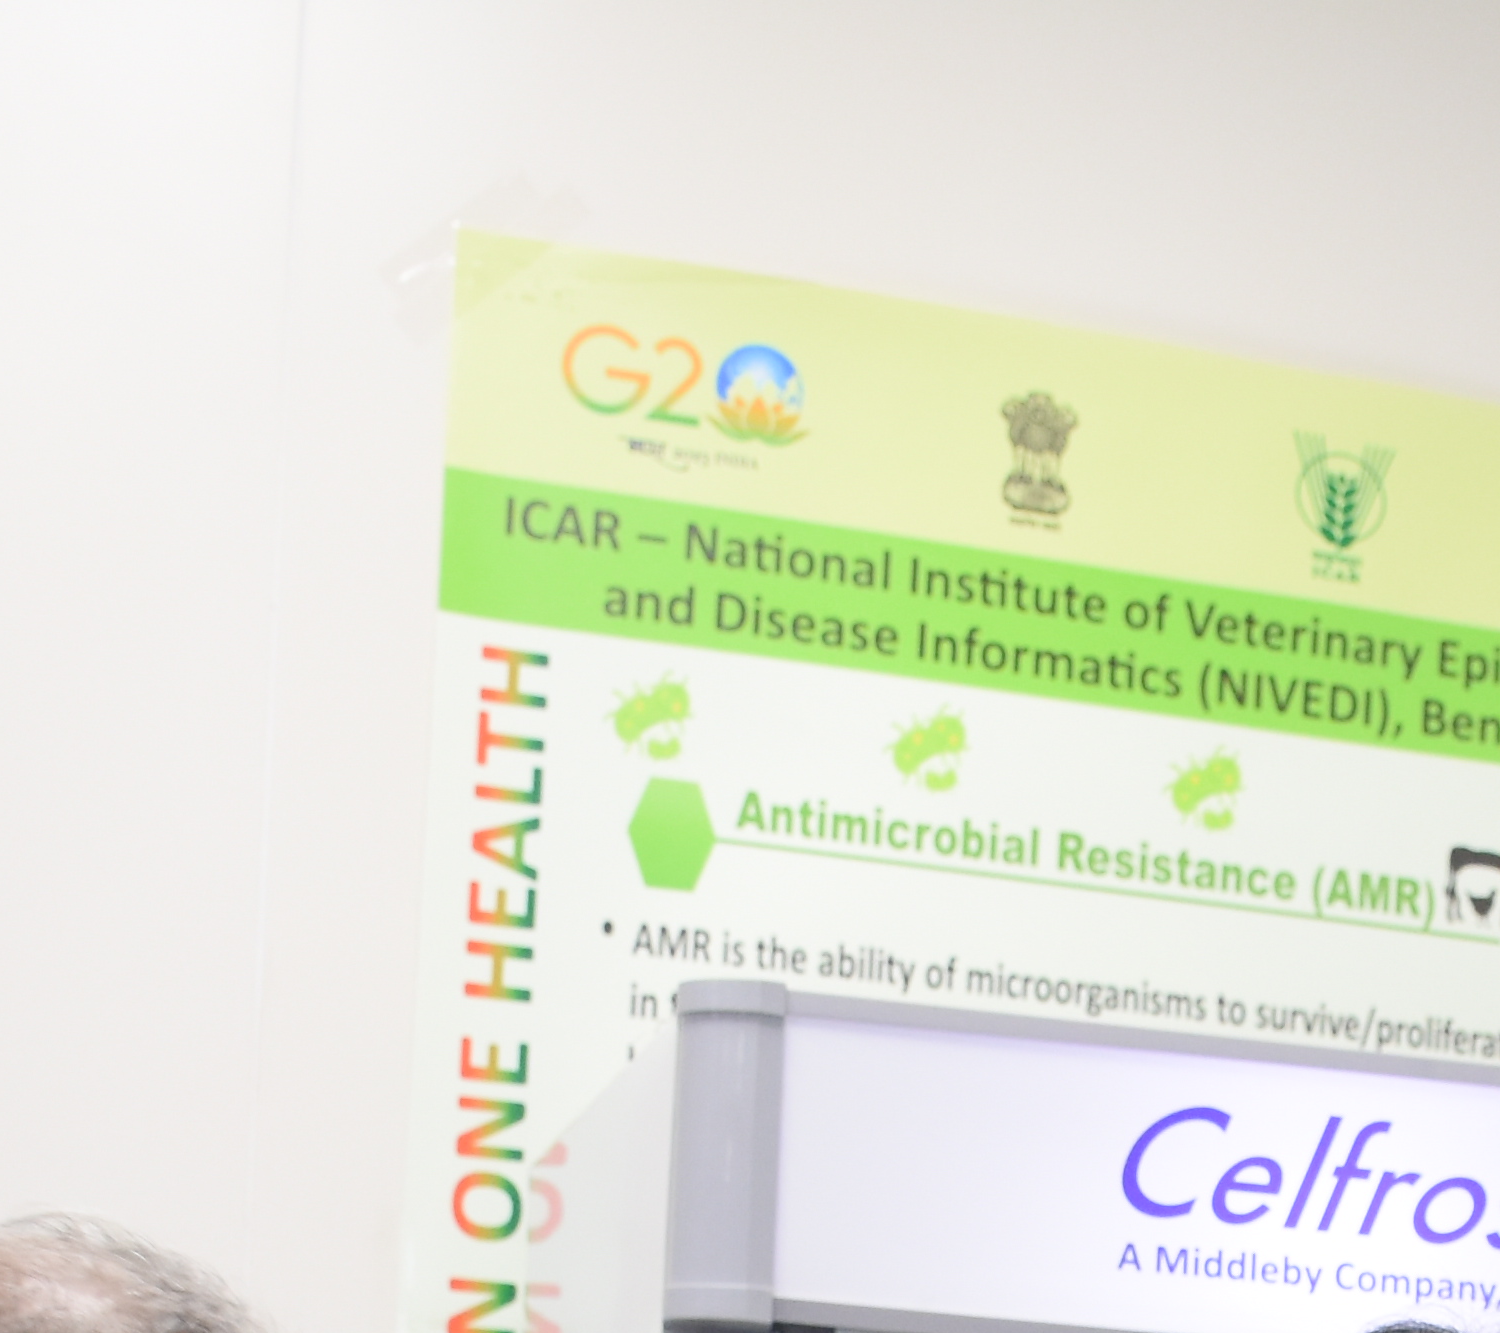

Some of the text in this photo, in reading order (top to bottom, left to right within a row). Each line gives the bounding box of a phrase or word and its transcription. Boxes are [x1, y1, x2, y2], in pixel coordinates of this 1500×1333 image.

[505, 497, 621, 551] ICAR
[686, 523, 891, 590] National
[910, 557, 1106, 624] Institute
[1125, 593, 1170, 630] of
[1186, 600, 1422, 679] Veterinary
[605, 584, 694, 626] and
[716, 593, 898, 656] Disease
[918, 623, 1181, 697] Informatics
[1200, 666, 1402, 738] (NIVEDI),
[464, 645, 550, 1002] HEALTH
[737, 790, 1435, 932] Antimicrobial Resistance (AMR)
[630, 985, 657, 1018] in
[633, 923, 711, 962] AMR
[722, 932, 745, 968] is
[756, 937, 806, 974] the
[818, 943, 915, 993] ability
[926, 956, 957, 989] of
[967, 961, 1206, 1020] microorganisms
[1217, 996, 1248, 1026] to
[453, 1037, 529, 1242] ONE
[1118, 1243, 1141, 1271] A
[1156, 1246, 1322, 1294] Middleby
